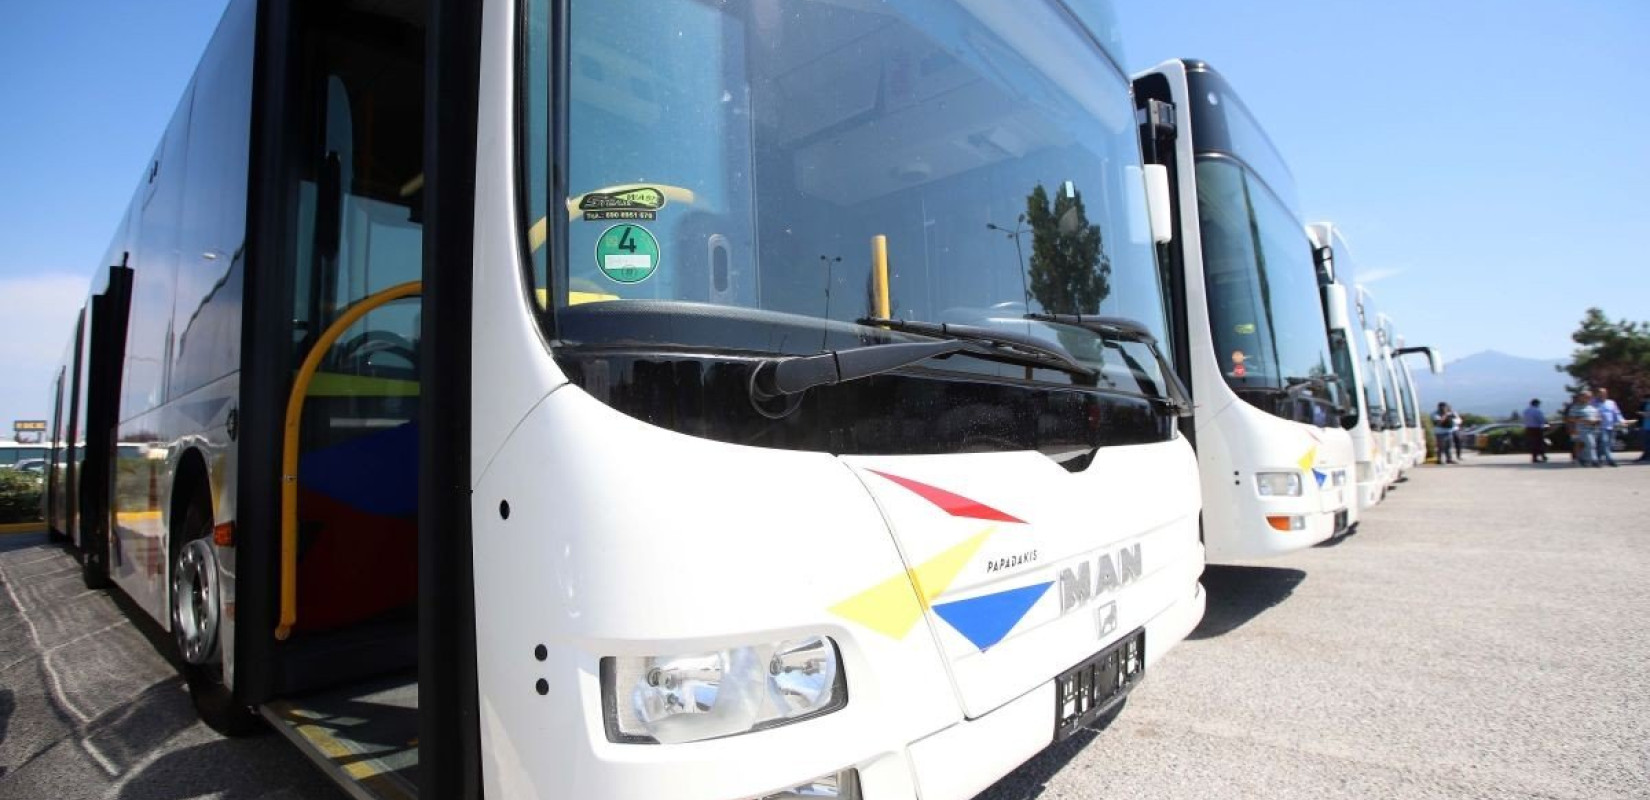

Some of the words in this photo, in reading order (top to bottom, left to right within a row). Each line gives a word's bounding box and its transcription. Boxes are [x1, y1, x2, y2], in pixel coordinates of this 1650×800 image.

[618, 226, 637, 253] 4
[986, 549, 1038, 573] PAPADAKIS
[1059, 542, 1143, 616] MAN
